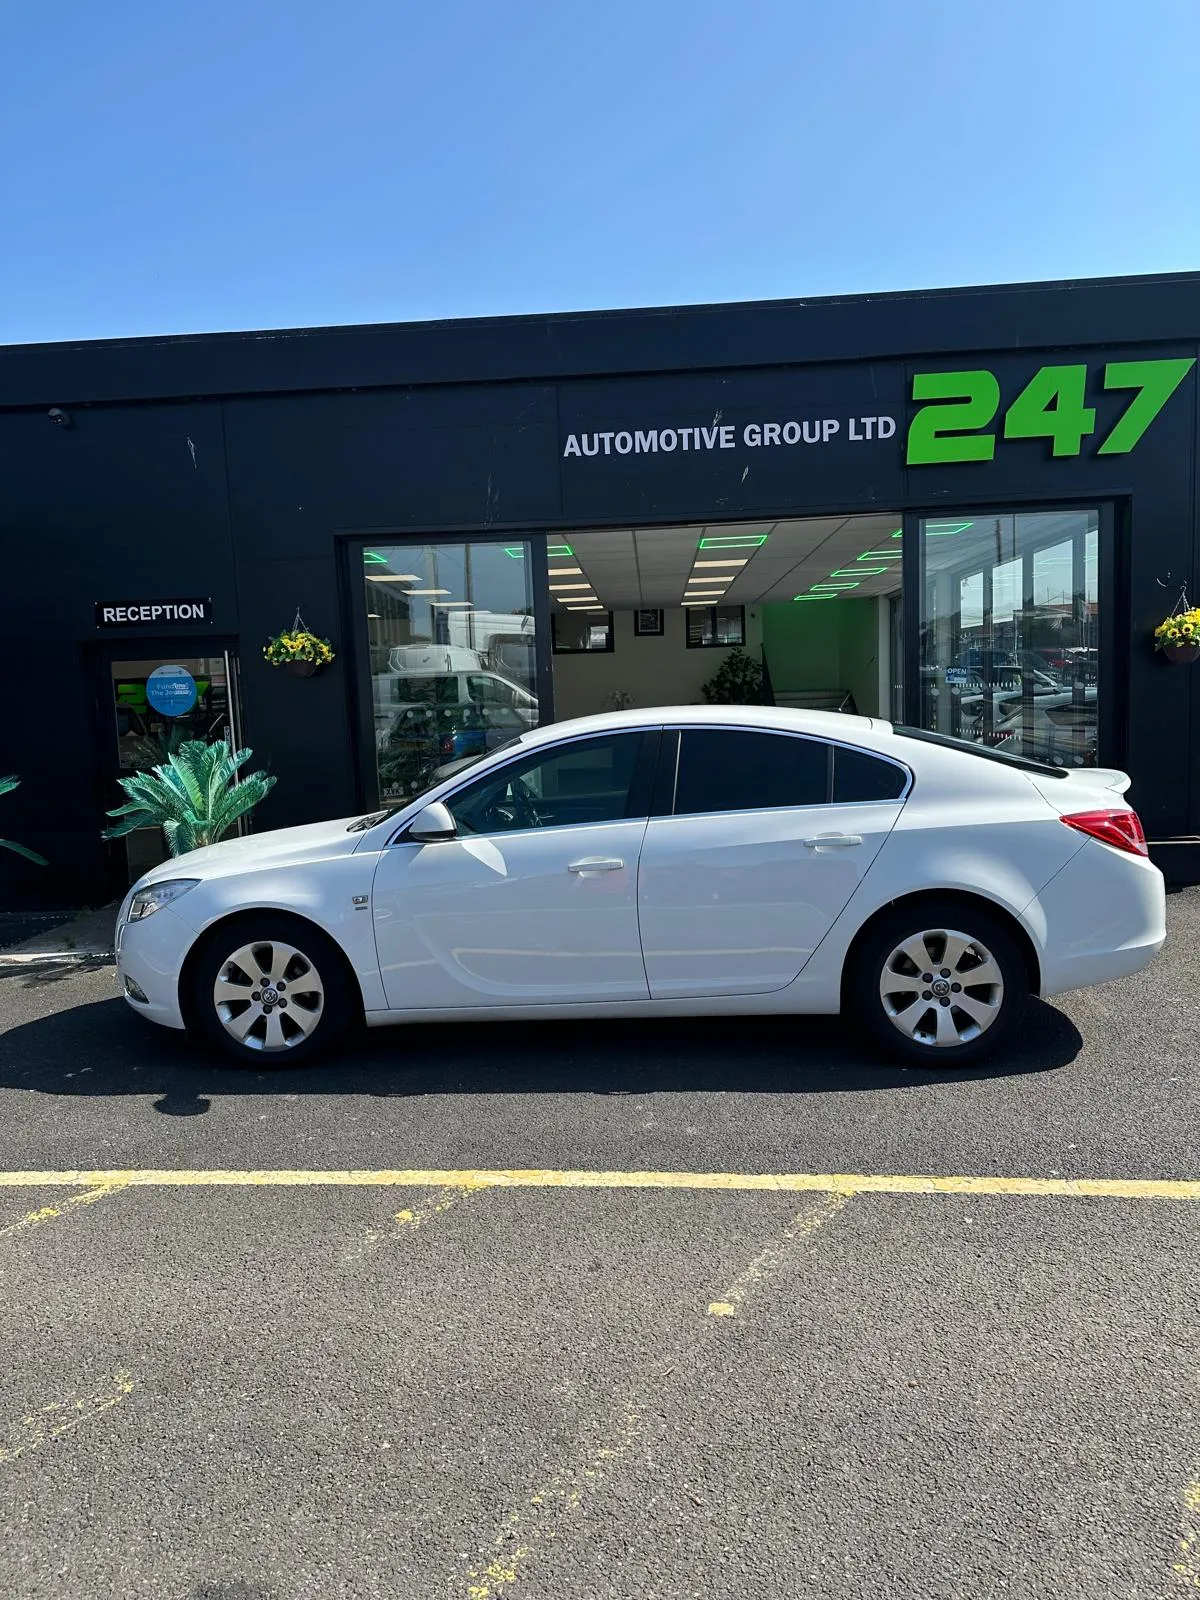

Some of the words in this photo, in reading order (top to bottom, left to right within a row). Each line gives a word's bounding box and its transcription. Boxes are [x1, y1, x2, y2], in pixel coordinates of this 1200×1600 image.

[906, 358, 1195, 465] 247
[563, 425, 736, 457] AUTOMOTIVE
[743, 419, 840, 447] GROUP
[848, 416, 896, 441] LTD
[103, 603, 205, 622] RECEPTION
[947, 667, 967, 675] OPEN
